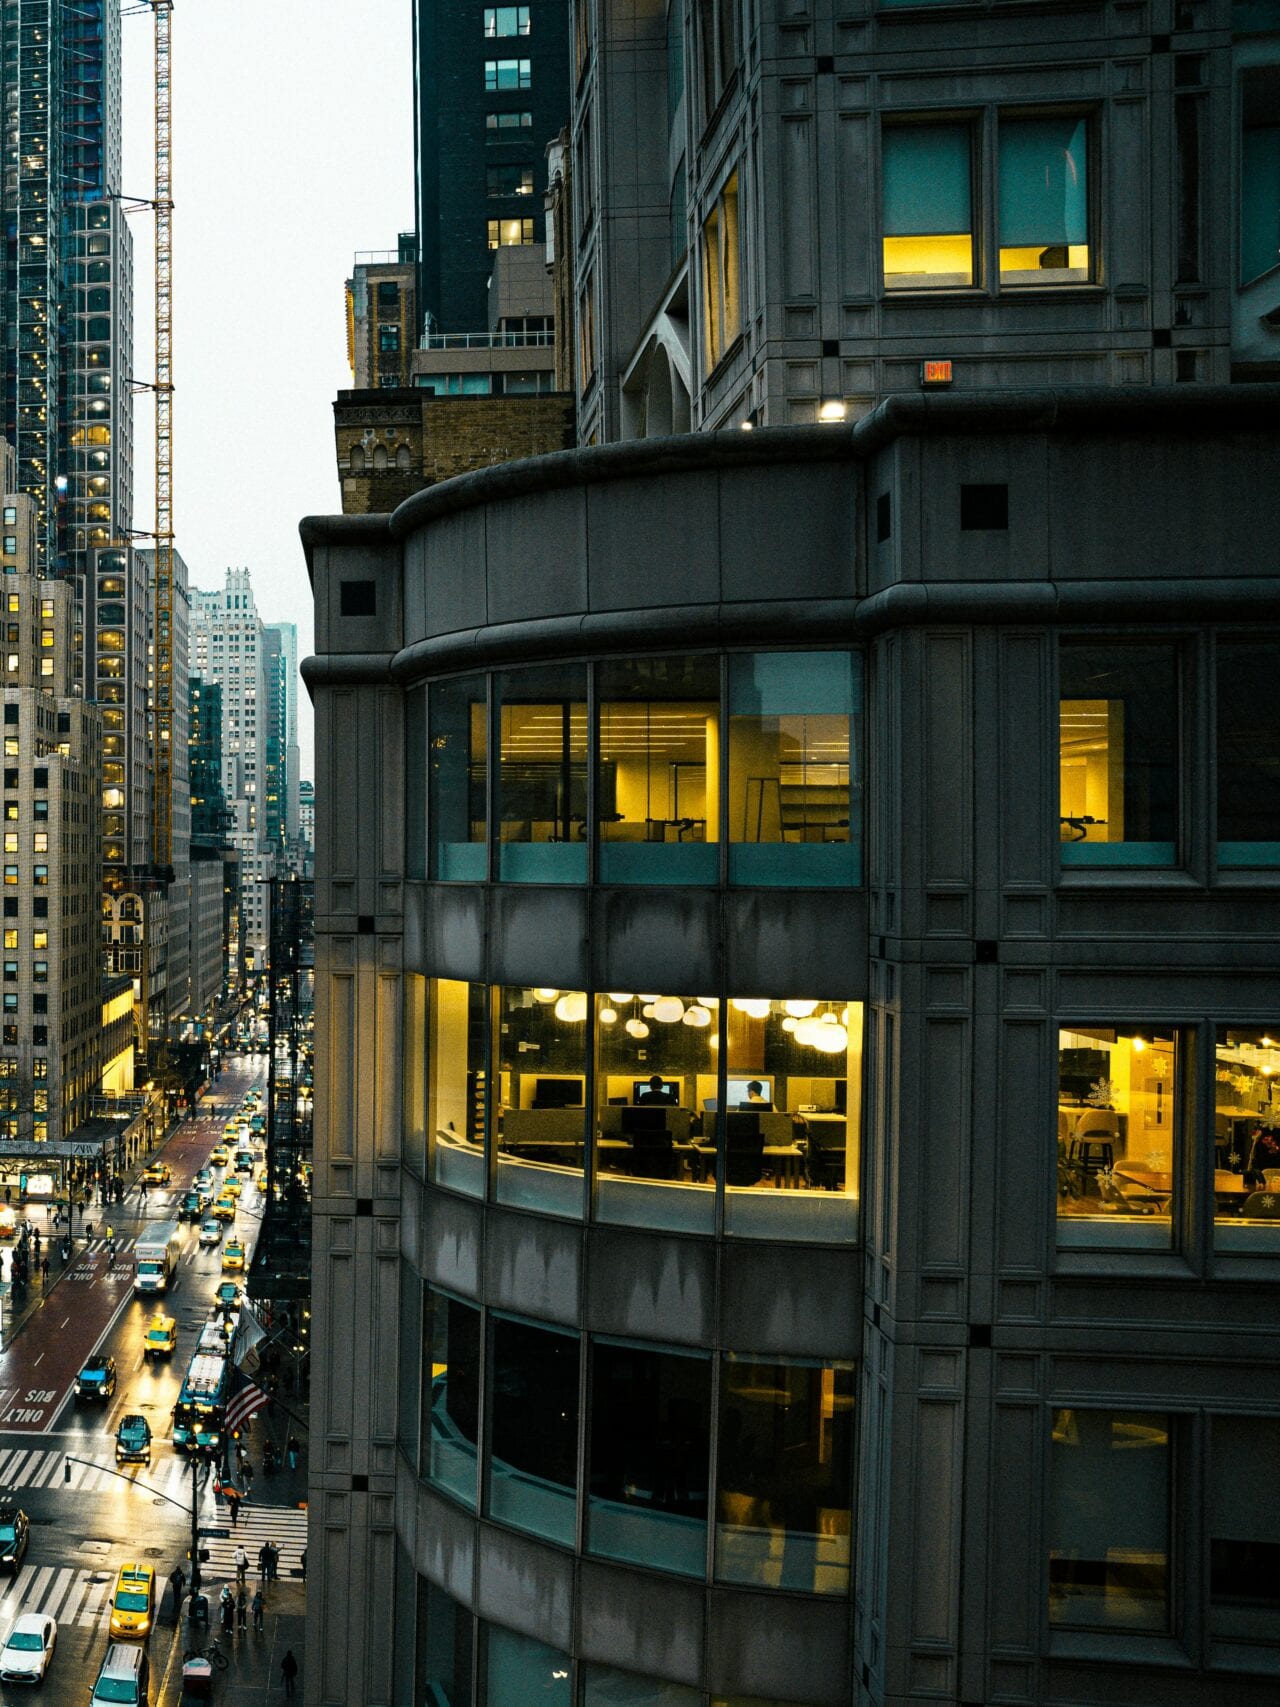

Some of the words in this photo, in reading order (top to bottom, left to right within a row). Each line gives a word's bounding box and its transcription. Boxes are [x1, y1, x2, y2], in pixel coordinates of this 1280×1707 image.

[927, 362, 951, 381] EXIT
[74, 1144, 93, 1154] ZARA
[25, 1389, 56, 1403] BUS
[2, 1408, 44, 1423] ONLY
